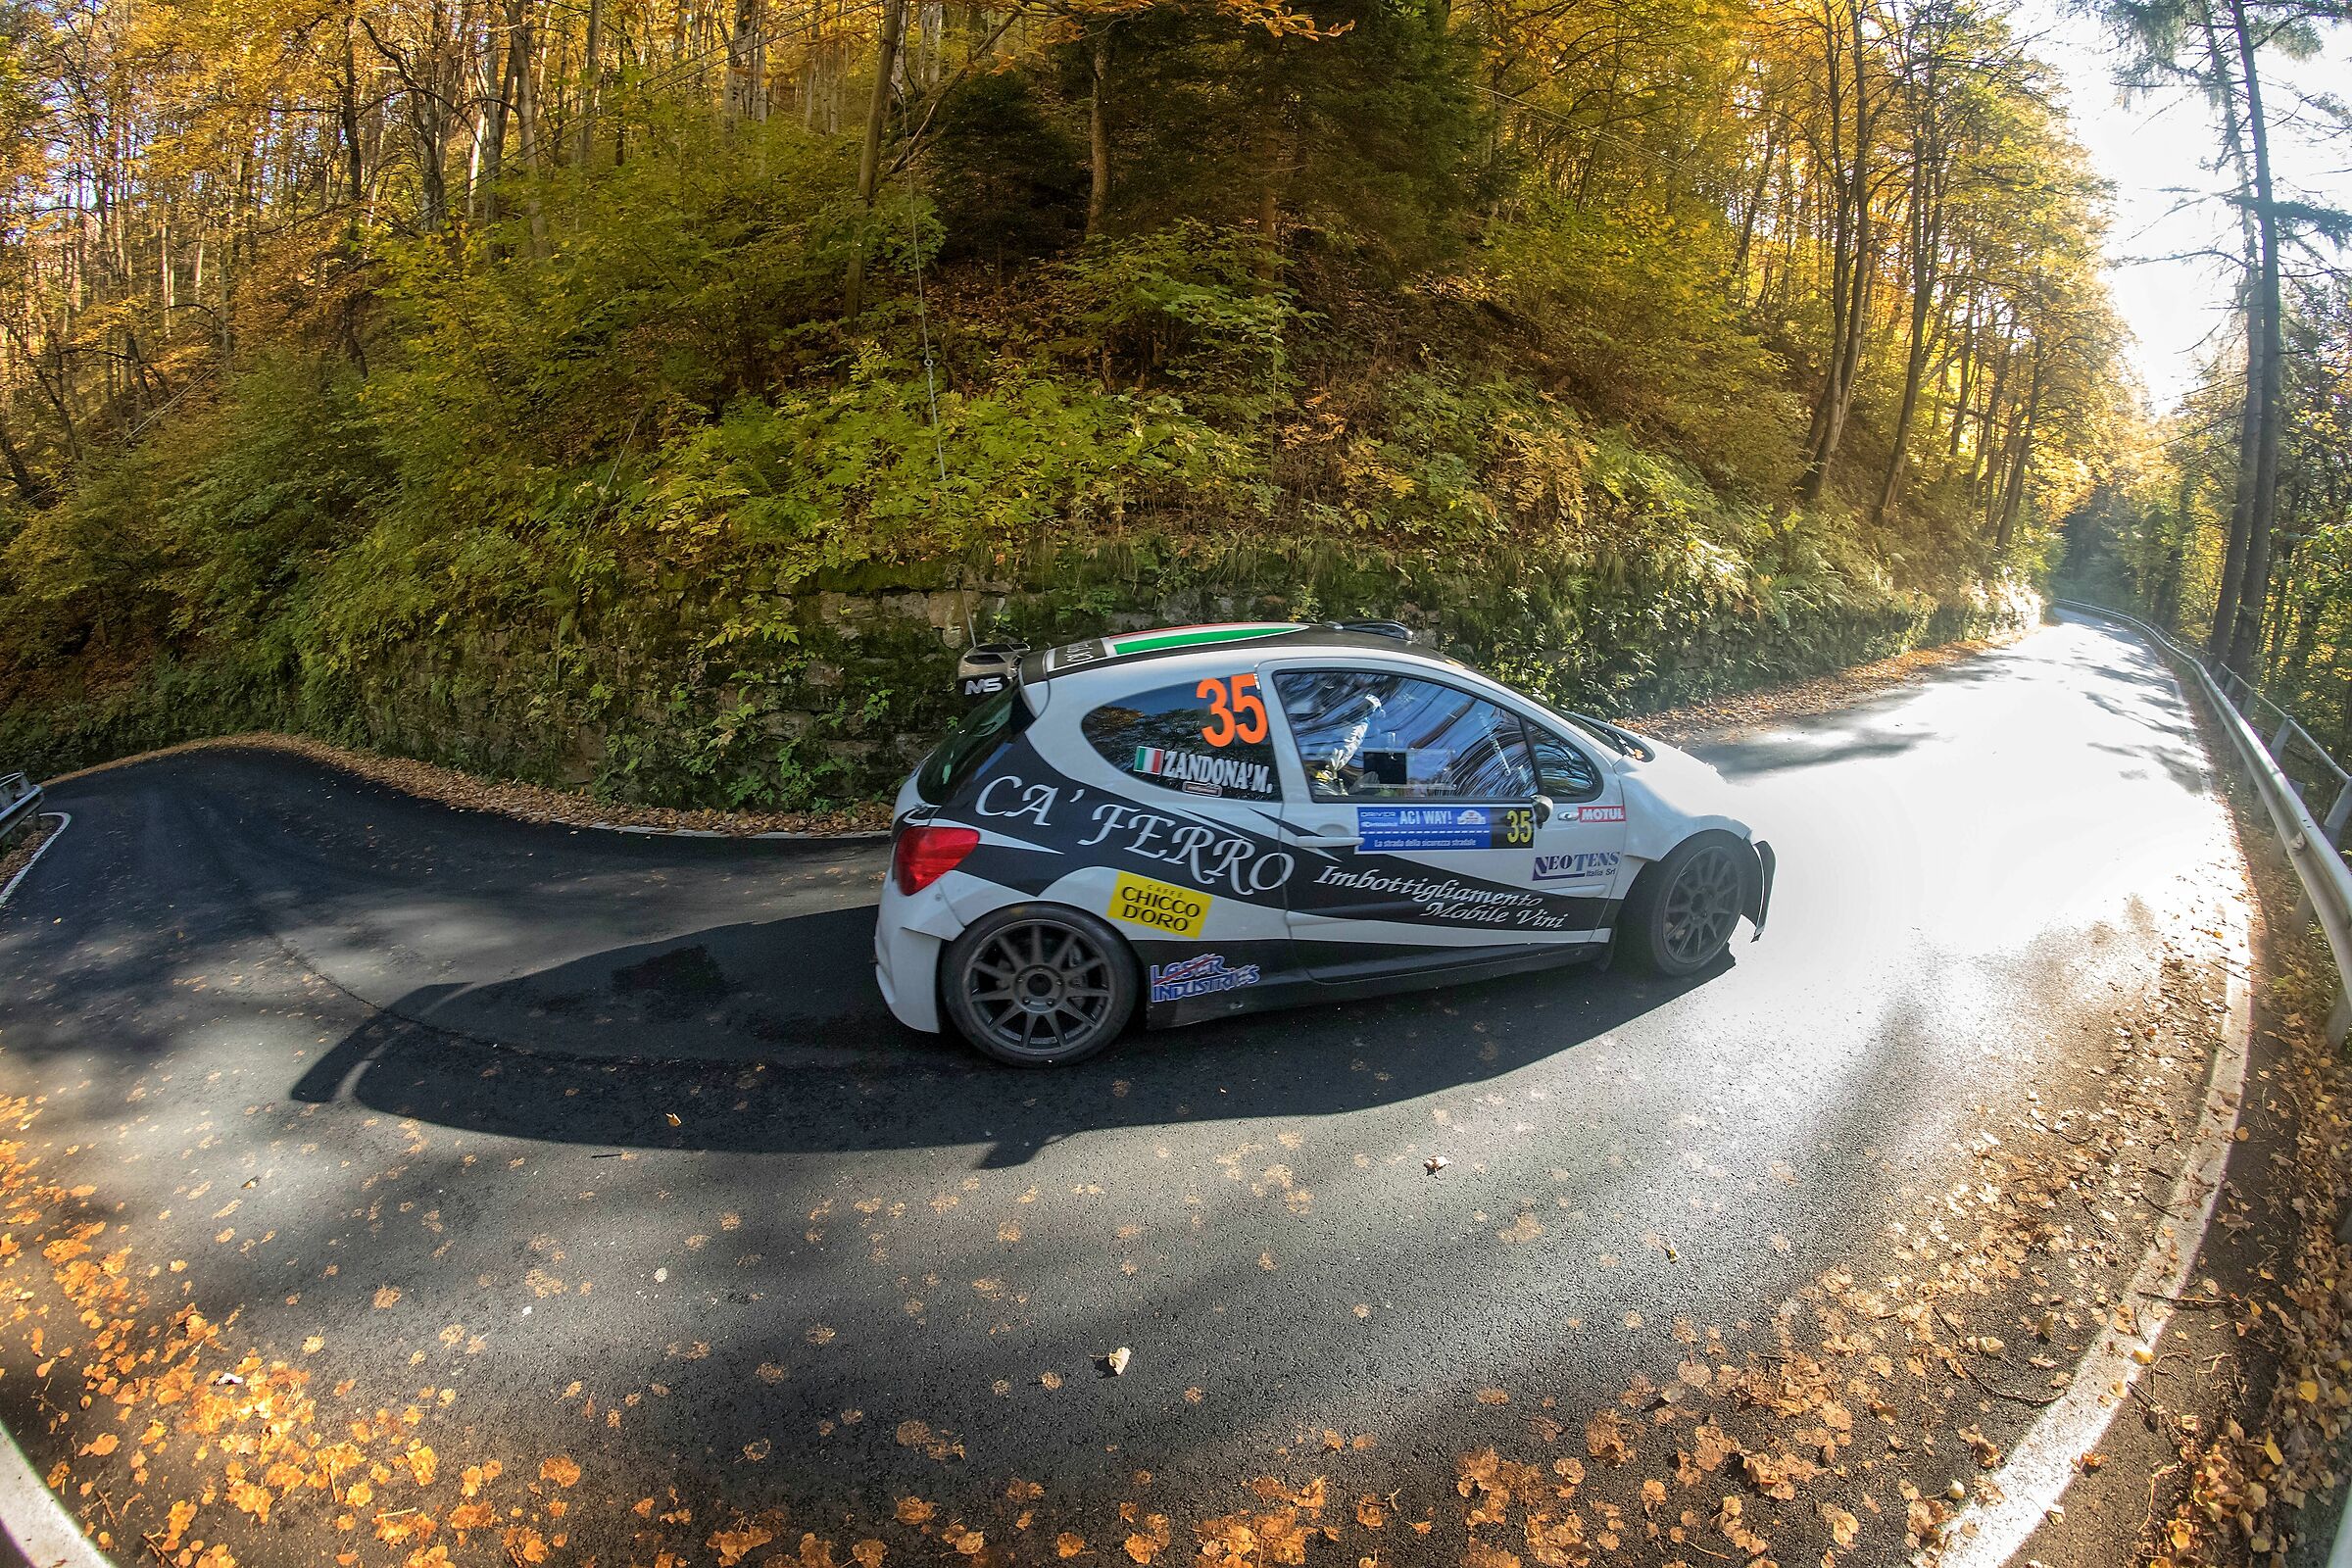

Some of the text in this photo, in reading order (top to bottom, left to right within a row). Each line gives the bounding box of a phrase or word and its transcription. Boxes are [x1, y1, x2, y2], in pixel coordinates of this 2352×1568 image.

[1197, 672, 1268, 748] 35
[1399, 810, 1420, 825] ACI
[1422, 810, 1452, 825] WAY!
[1506, 810, 1533, 843] 35
[1582, 808, 1624, 820] MOTUL
[974, 775, 1296, 896] CA' FERRO
[1374, 839, 1383, 848] La
[1533, 852, 1621, 876] NEOTENS
[1313, 865, 1544, 906] Imbottigliamento
[1122, 886, 1200, 917] CHICCO
[1419, 902, 1568, 928] Mobile Vini
[1122, 905, 1188, 931] D'ORO
[1151, 965, 1260, 1003] INDUSTRIES
